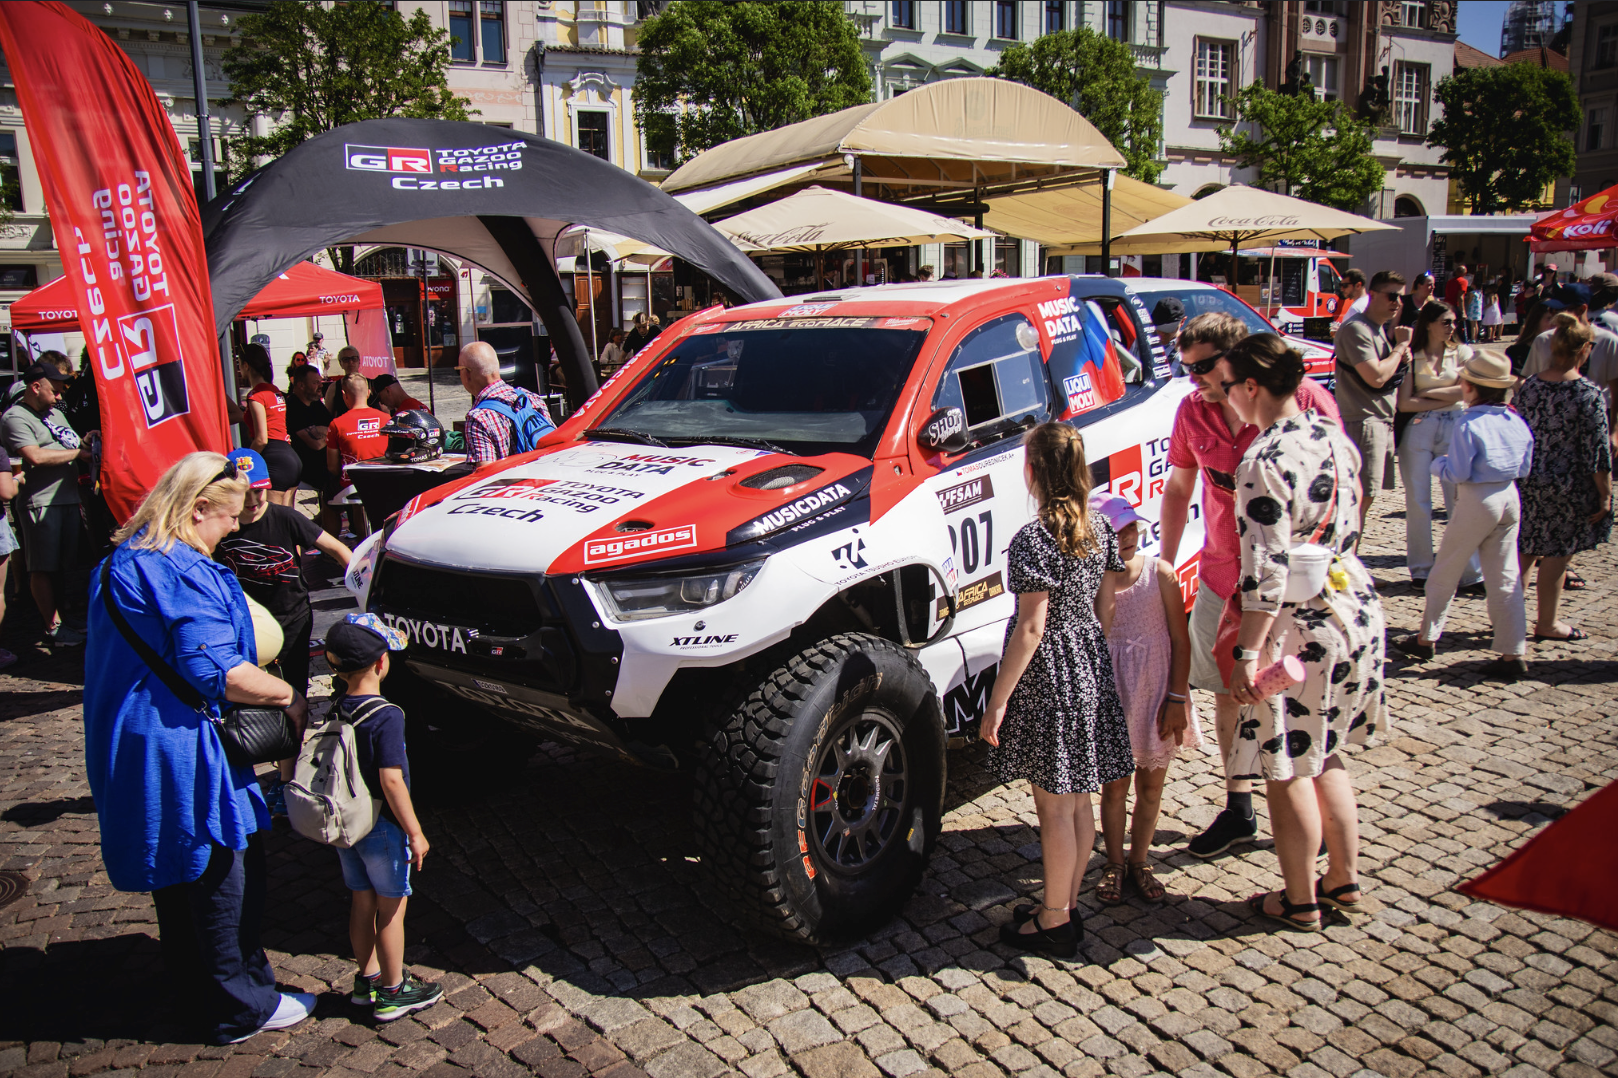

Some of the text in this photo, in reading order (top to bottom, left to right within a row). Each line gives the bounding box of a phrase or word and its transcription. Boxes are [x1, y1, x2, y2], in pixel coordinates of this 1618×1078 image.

[436, 140, 528, 157] TOYOTA
[350, 154, 429, 172] GR
[438, 151, 522, 165] GAZOO
[440, 160, 523, 173] Racing
[392, 174, 505, 190] Czech
[319, 294, 361, 304] TOYOTA
[1037, 296, 1080, 319] MUSIC
[38, 310, 78, 320] TOYOT
[723, 318, 786, 332] AFRICA
[1044, 315, 1082, 338] DATA
[1051, 337, 1062, 345] PLUG
[1065, 374, 1091, 394] LIQUI
[1069, 391, 1095, 411] MOLY
[359, 422, 379, 430] GR
[928, 413, 962, 447] SHOT
[410, 453, 428, 463] TOMAS
[618, 453, 716, 467] MUSIC
[594, 461, 675, 475] DATA
[538, 487, 620, 505] GAZOO
[559, 480, 646, 499] TOYOTA
[950, 478, 982, 506] FSAM
[519, 492, 600, 513] Racing
[752, 483, 852, 535] MUSICDATA
[447, 503, 544, 523] Czech
[790, 520, 816, 532] PLUG
[823, 506, 846, 518] PLAY
[589, 530, 691, 556] agados
[834, 572, 865, 586] TOYOTA
[957, 581, 988, 603] AFRICA
[383, 612, 467, 655] TOYOTA
[669, 633, 740, 647] XTLINE
[491, 648, 504, 656] GR
[434, 679, 601, 733] TOYOTA
